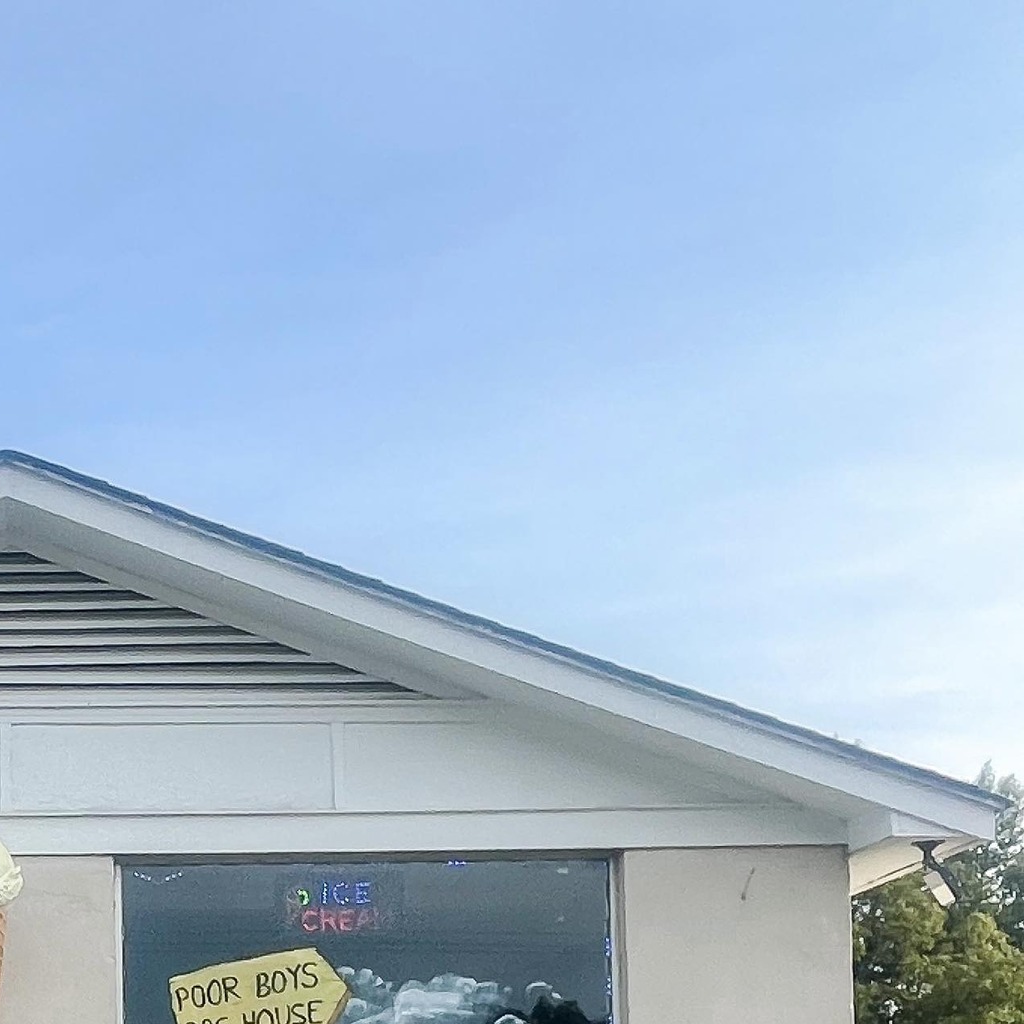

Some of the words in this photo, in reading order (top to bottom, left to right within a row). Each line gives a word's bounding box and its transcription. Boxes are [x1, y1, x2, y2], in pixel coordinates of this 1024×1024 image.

[322, 882, 371, 905] ICE
[302, 908, 381, 932] CREA
[175, 976, 241, 1011] POOR
[256, 962, 319, 998] BOYS
